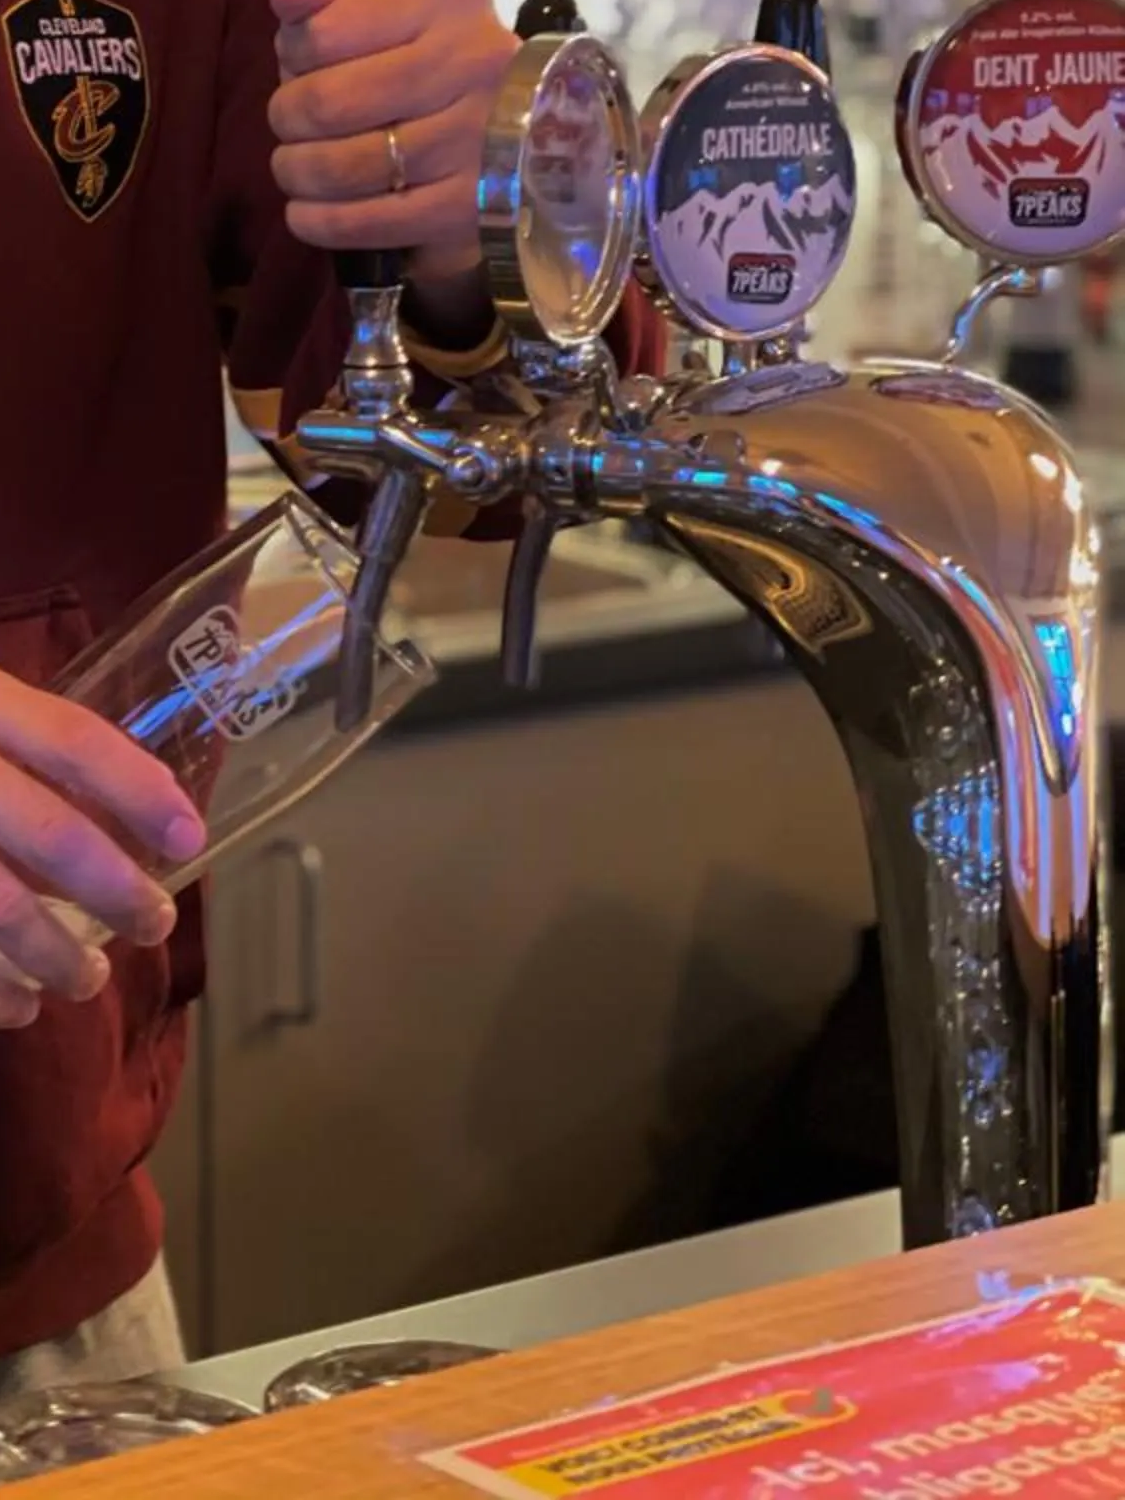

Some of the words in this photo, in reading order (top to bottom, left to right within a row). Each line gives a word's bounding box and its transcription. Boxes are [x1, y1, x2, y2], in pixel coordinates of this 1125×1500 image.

[38, 17, 107, 37] CLEVELAND
[15, 36, 142, 85] CAVALIERS
[973, 53, 1040, 89] DENT
[1044, 50, 1125, 86] JAUNE
[701, 115, 834, 160] CATHÉDRALE
[1014, 193, 1082, 219] 7PEAKS
[731, 269, 790, 295] 7PEAKS
